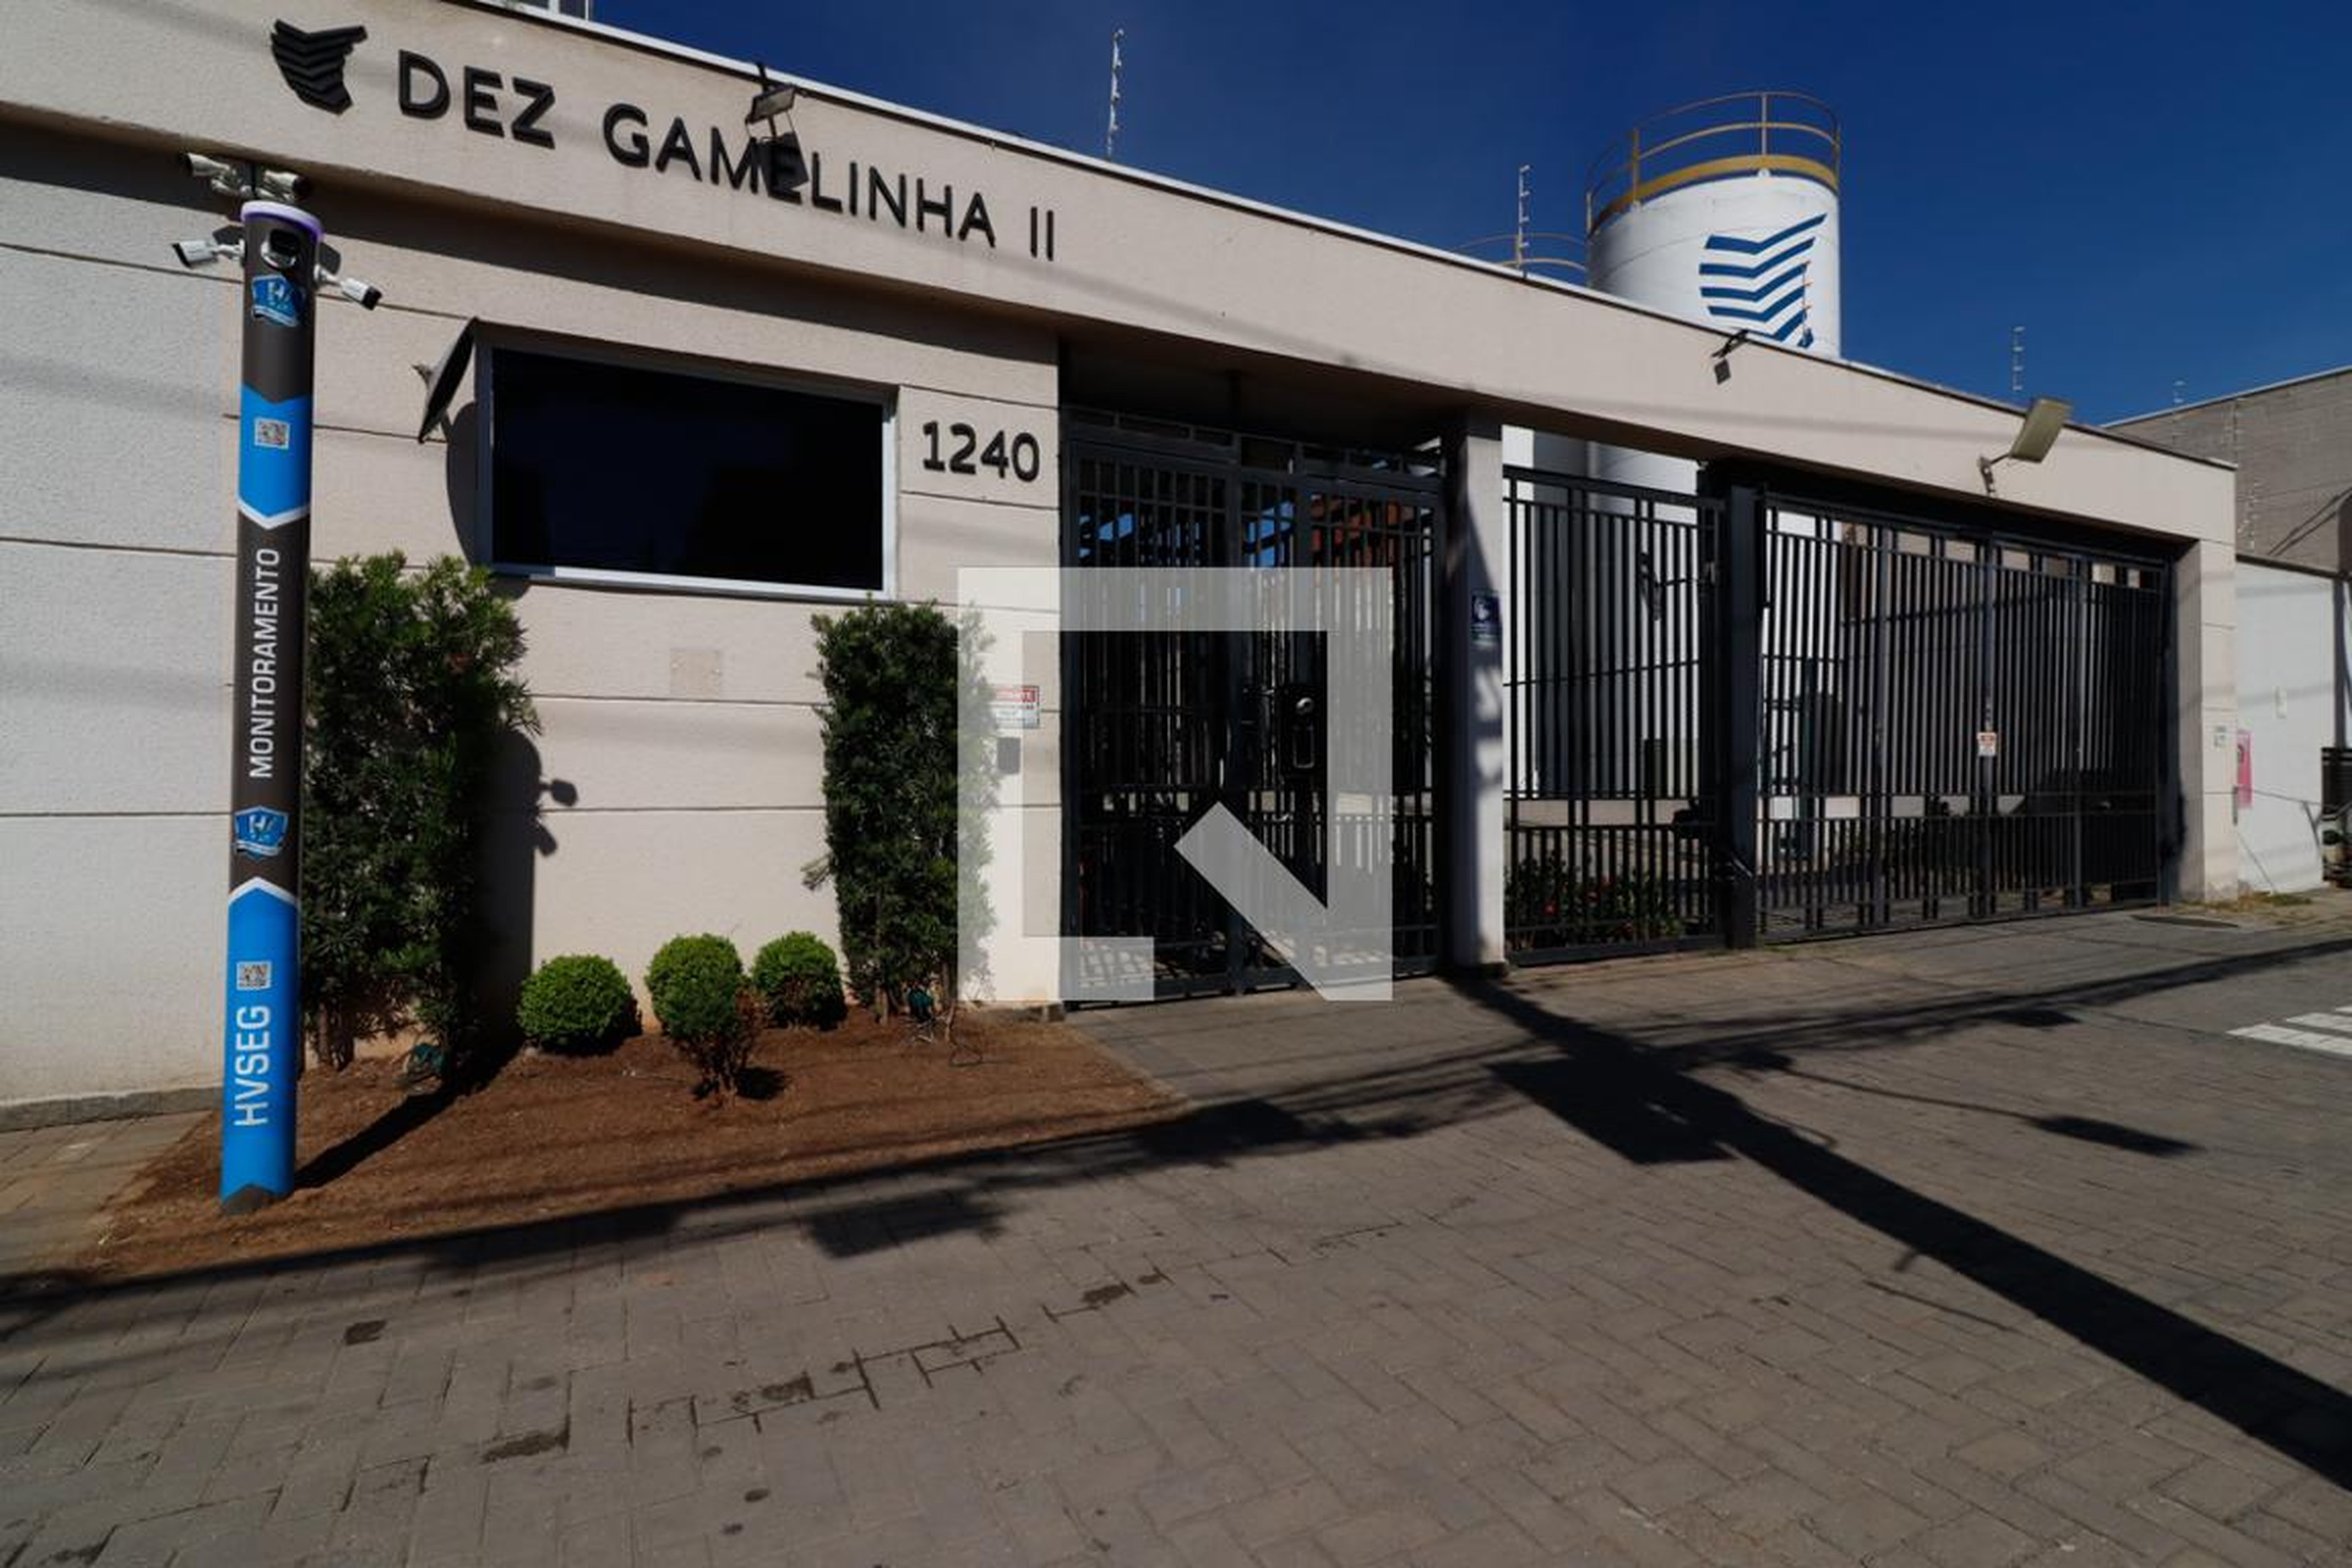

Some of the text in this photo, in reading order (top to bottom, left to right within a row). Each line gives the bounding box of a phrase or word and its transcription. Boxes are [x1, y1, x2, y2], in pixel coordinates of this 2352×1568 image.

[399, 48, 1054, 261] DEZ GAMELINHA II
[922, 420, 1039, 482] 1240
[249, 548, 280, 779] MONITORAMENTO
[233, 1004, 271, 1127] HVSEG
